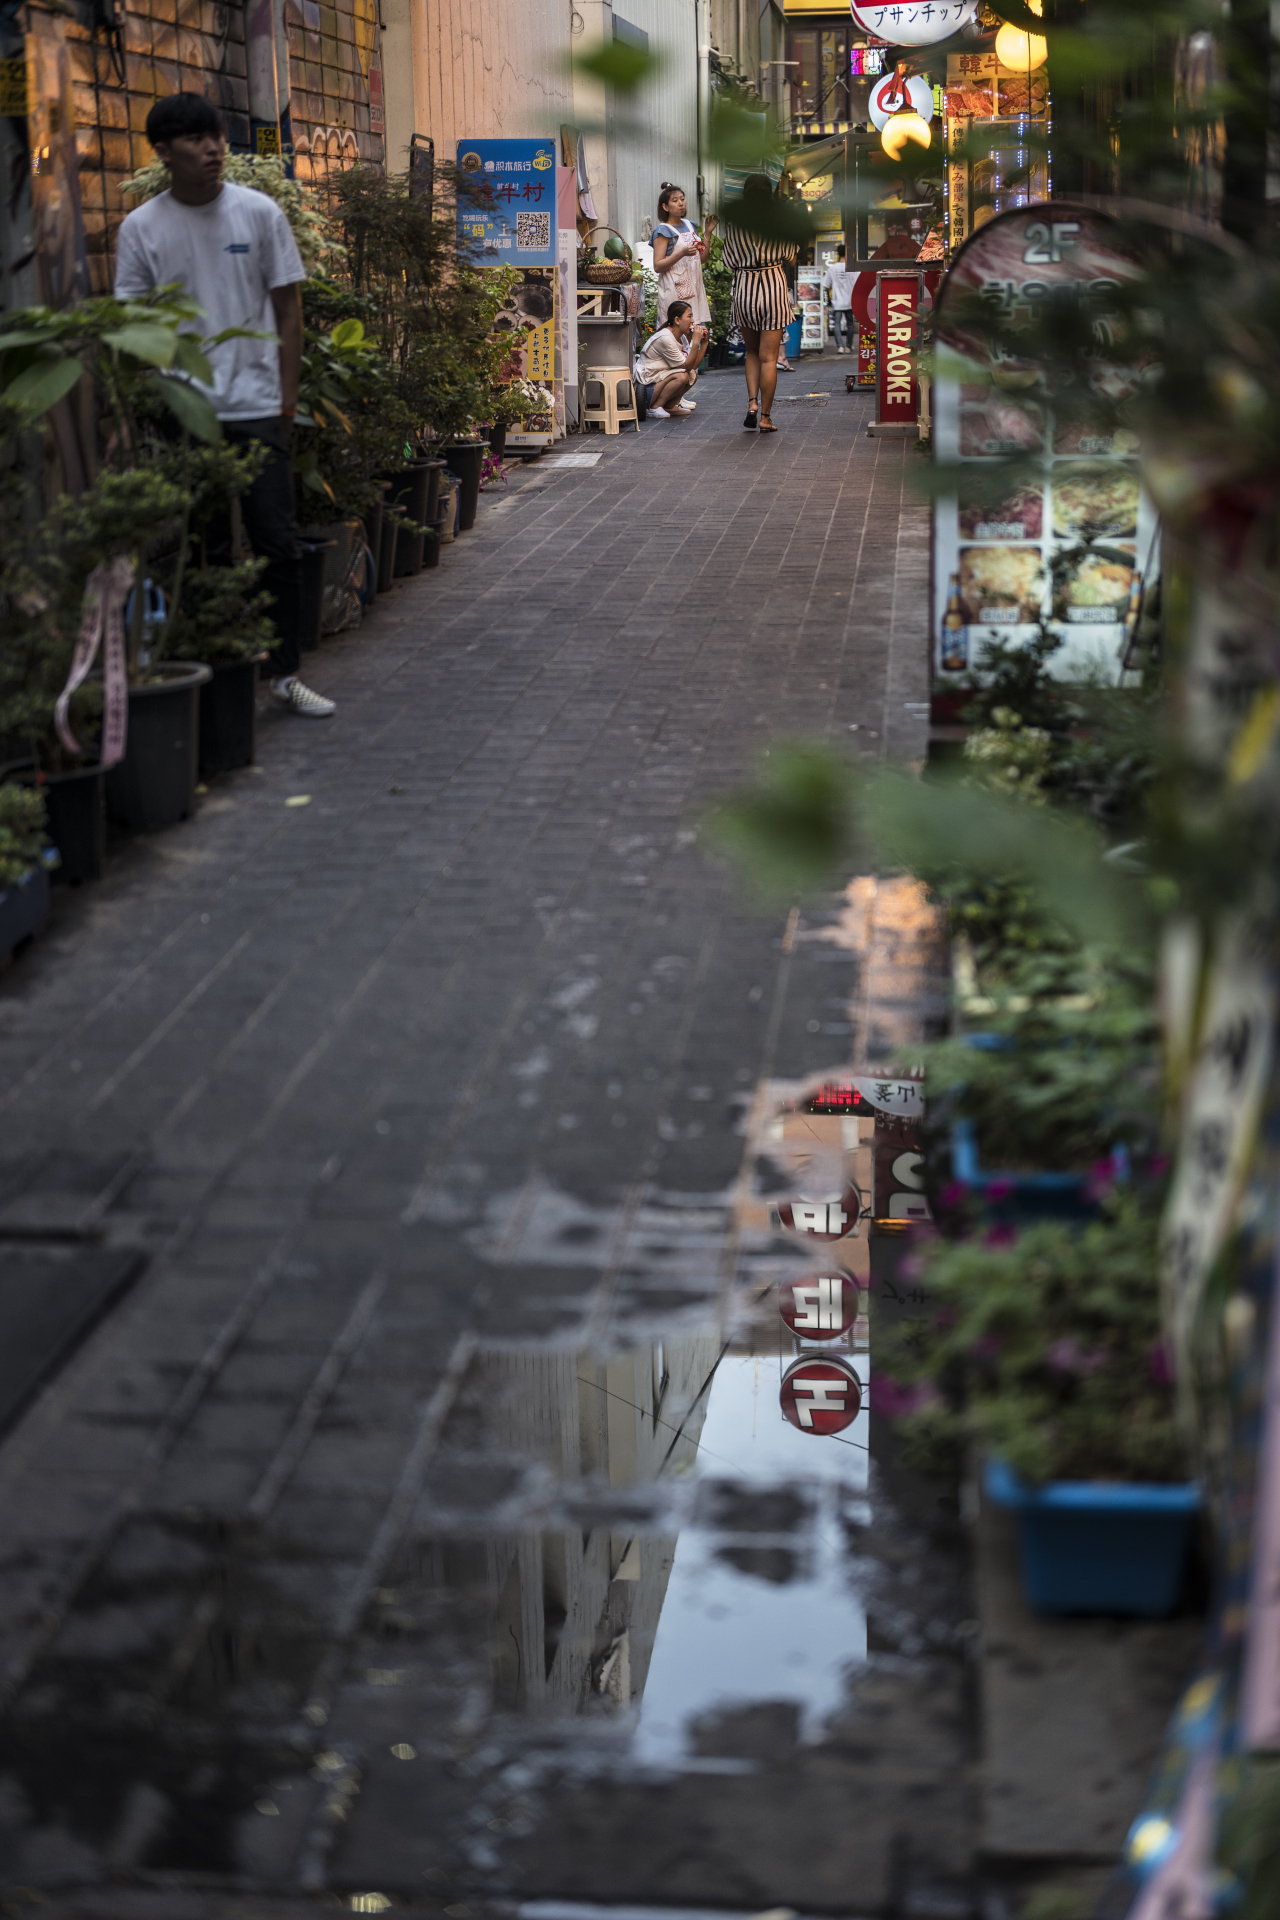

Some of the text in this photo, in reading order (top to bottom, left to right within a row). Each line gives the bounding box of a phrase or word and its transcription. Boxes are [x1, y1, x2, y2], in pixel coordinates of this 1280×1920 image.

[874, 0, 967, 27] プサンチップ
[959, 54, 1028, 75] 韓牛
[496, 161, 531, 171] 积木旅行
[801, 189, 827, 198] ssage
[1023, 222, 1081, 264] 2F
[887, 294, 912, 405] KARAOKE
